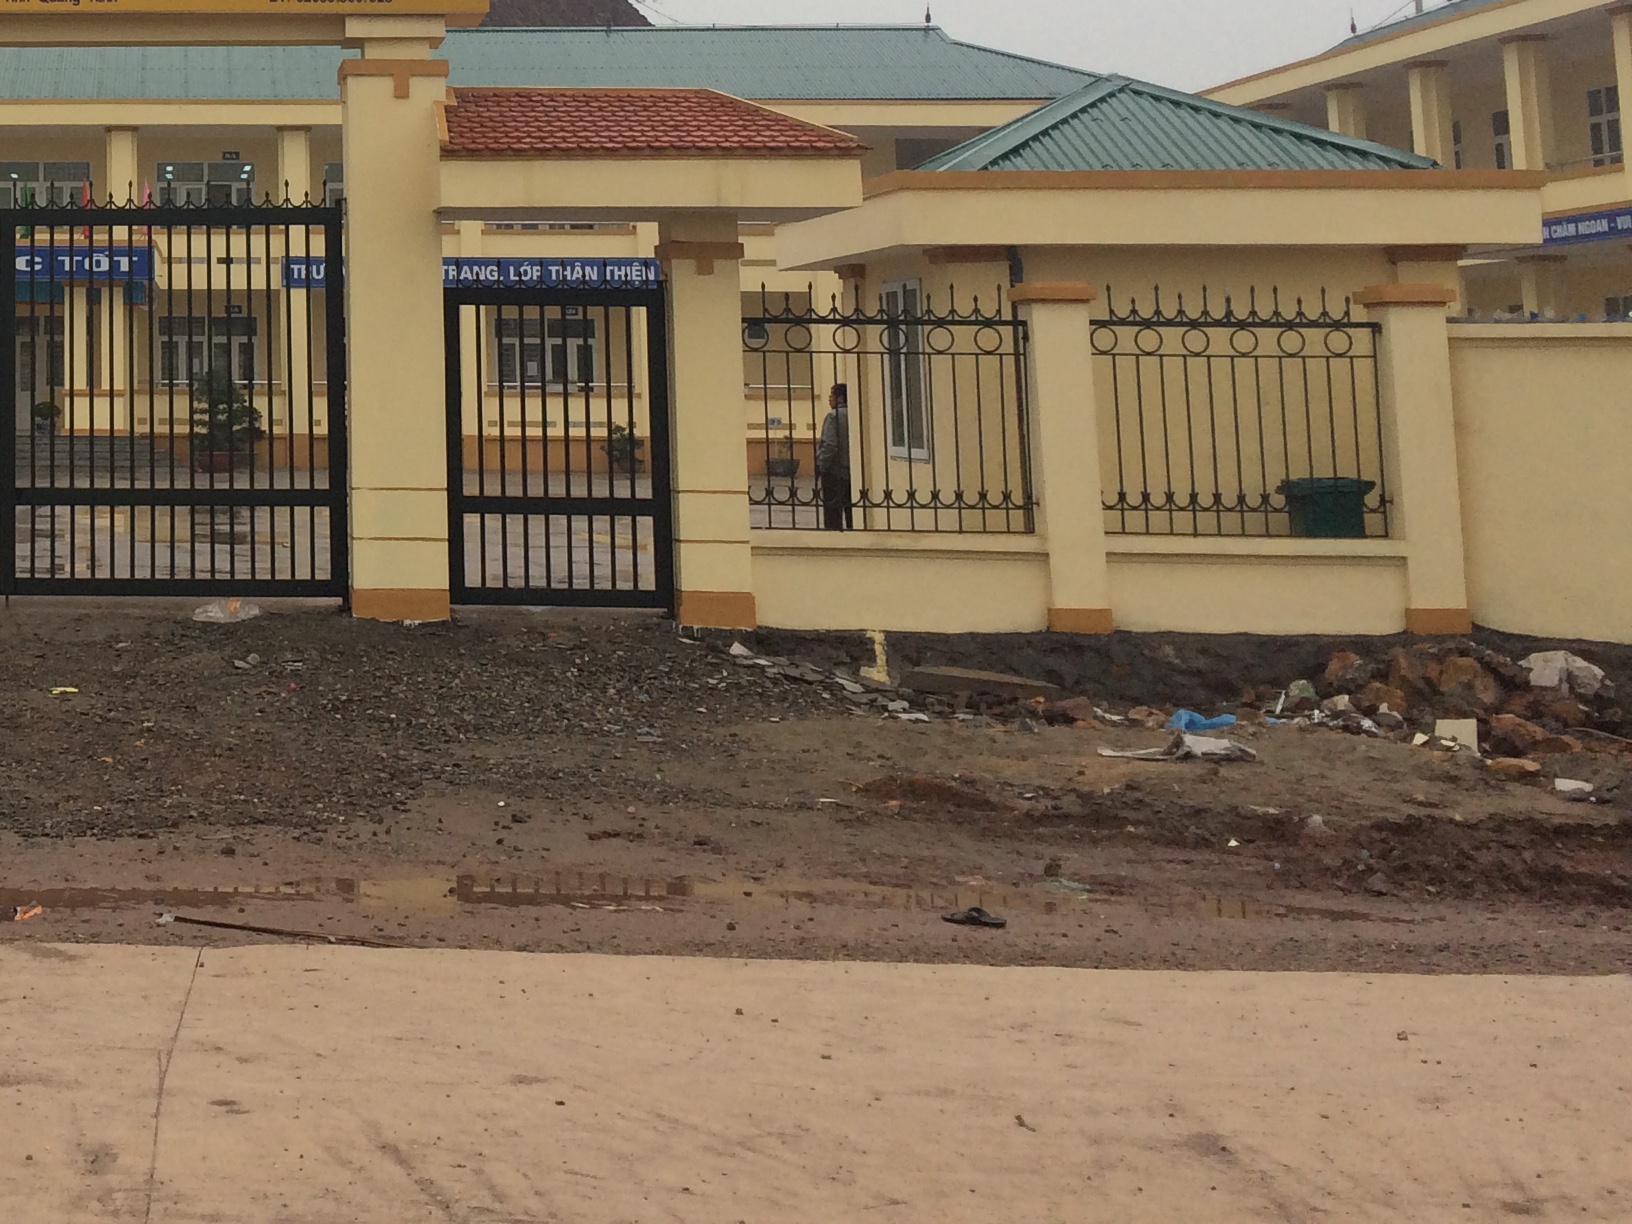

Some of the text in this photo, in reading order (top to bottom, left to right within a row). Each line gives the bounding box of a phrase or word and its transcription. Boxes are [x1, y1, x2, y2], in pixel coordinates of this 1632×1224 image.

[58, 251, 139, 272] TỐT
[509, 261, 541, 280] LỚP
[548, 262, 598, 280] THÂN
[606, 262, 655, 285] THIỆN
